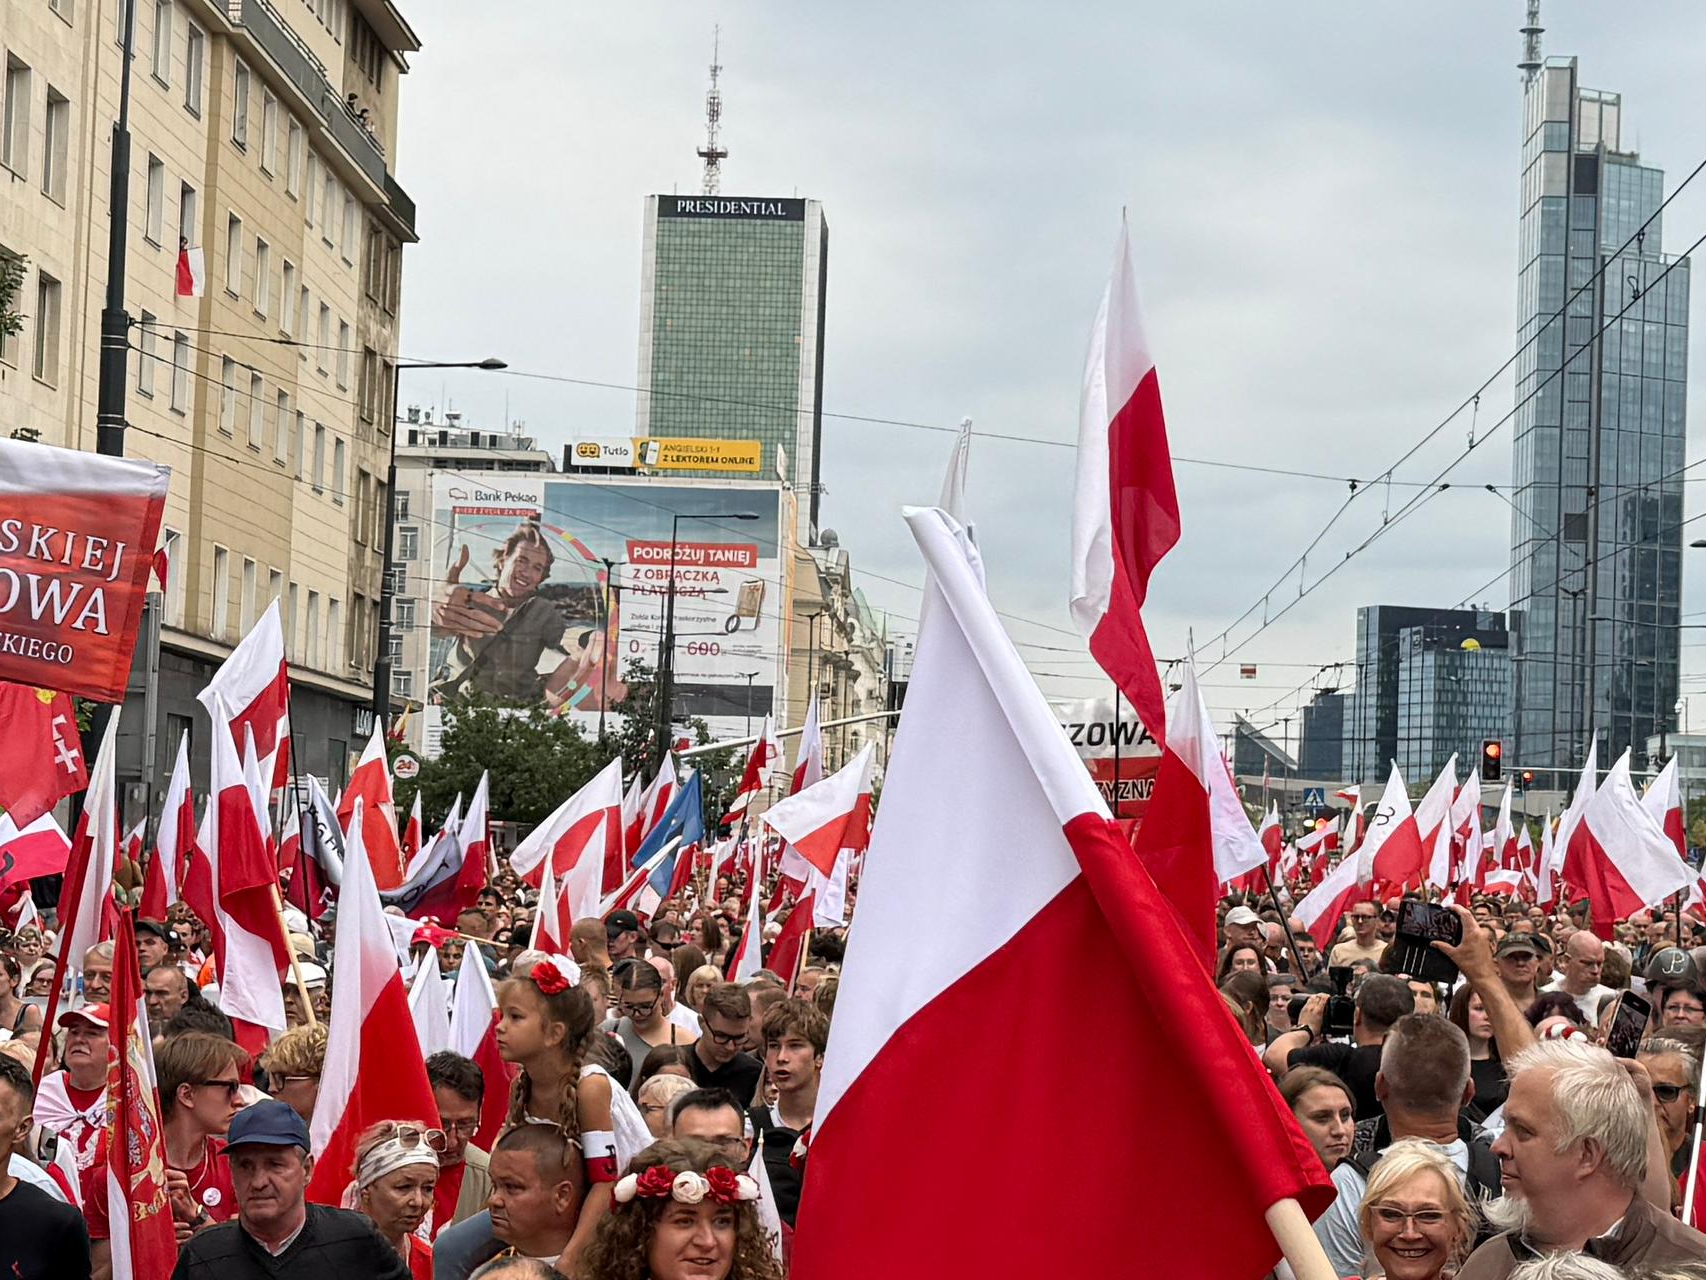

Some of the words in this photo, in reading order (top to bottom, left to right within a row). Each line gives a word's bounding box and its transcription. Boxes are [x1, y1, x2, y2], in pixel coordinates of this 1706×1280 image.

[677, 200, 786, 215] PRESIDENTIAL
[670, 455, 719, 464] LEKTOREM
[721, 456, 755, 465] ONLINE
[475, 490, 502, 501] Bank
[504, 491, 537, 503] Pekao
[633, 544, 705, 564] PODRÓŻUJ
[707, 549, 750, 565] TANIEJ
[633, 568, 641, 579] Z
[687, 641, 721, 656] 600
